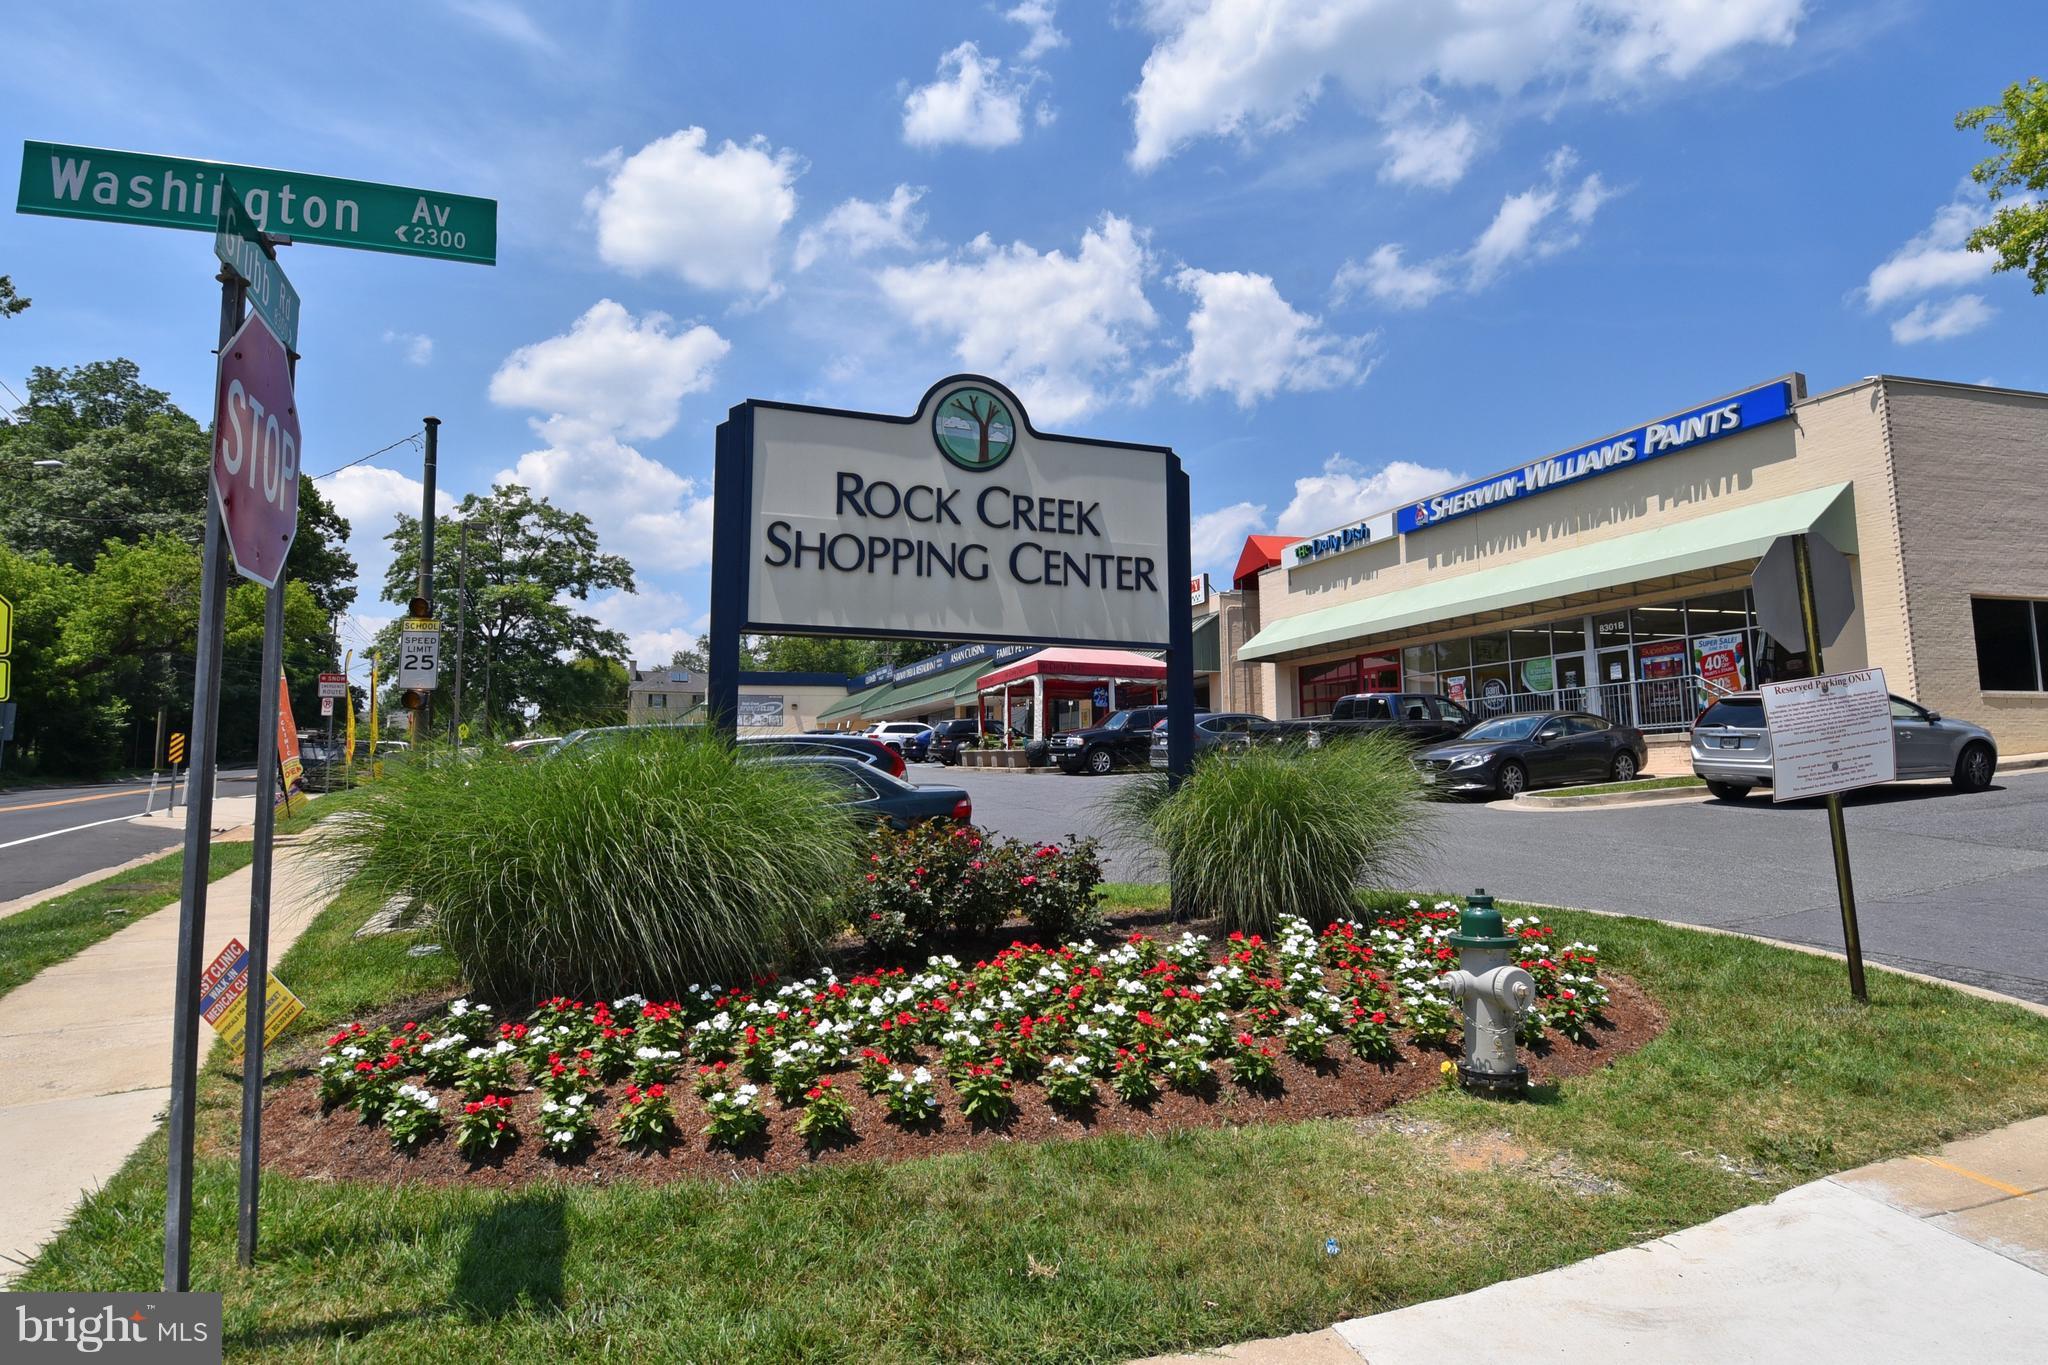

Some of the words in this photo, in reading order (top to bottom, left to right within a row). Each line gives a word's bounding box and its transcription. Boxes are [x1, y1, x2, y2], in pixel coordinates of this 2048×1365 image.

[411, 196, 451, 227] Av
[413, 227, 466, 249] 2300
[226, 207, 270, 306] Grubb
[279, 282, 292, 321] Rd
[222, 378, 296, 512] STOP
[1429, 437, 1637, 522] SHERWIN-WILLIAMS
[1644, 402, 1741, 455] PAINTS
[836, 471, 961, 526] ROCK
[976, 486, 1101, 537] CREEK
[1312, 538, 1340, 556] Daily
[1341, 522, 1370, 546] Dish
[764, 520, 989, 582] SHOPPING
[1008, 541, 1159, 593] CENTER
[404, 622, 438, 630] SCHOOL
[1600, 621, 1624, 632] 8301B
[405, 636, 437, 645] SPEED
[407, 645, 433, 653] LIMIT
[1698, 640, 1717, 648] SUPER
[404, 654, 434, 671] 25
[950, 650, 965, 664] ASIAN
[964, 643, 985, 659] CUISINE
[996, 645, 1014, 659] FAMILY
[1704, 653, 1729, 671] 40%
[1774, 681, 1814, 695] Reserved
[1815, 677, 1848, 690] Parking
[1848, 671, 1873, 684] ONLY
[210, 943, 241, 978] CLINIC
[209, 980, 229, 1000] WALK
[206, 988, 239, 1022] MEDICAL
